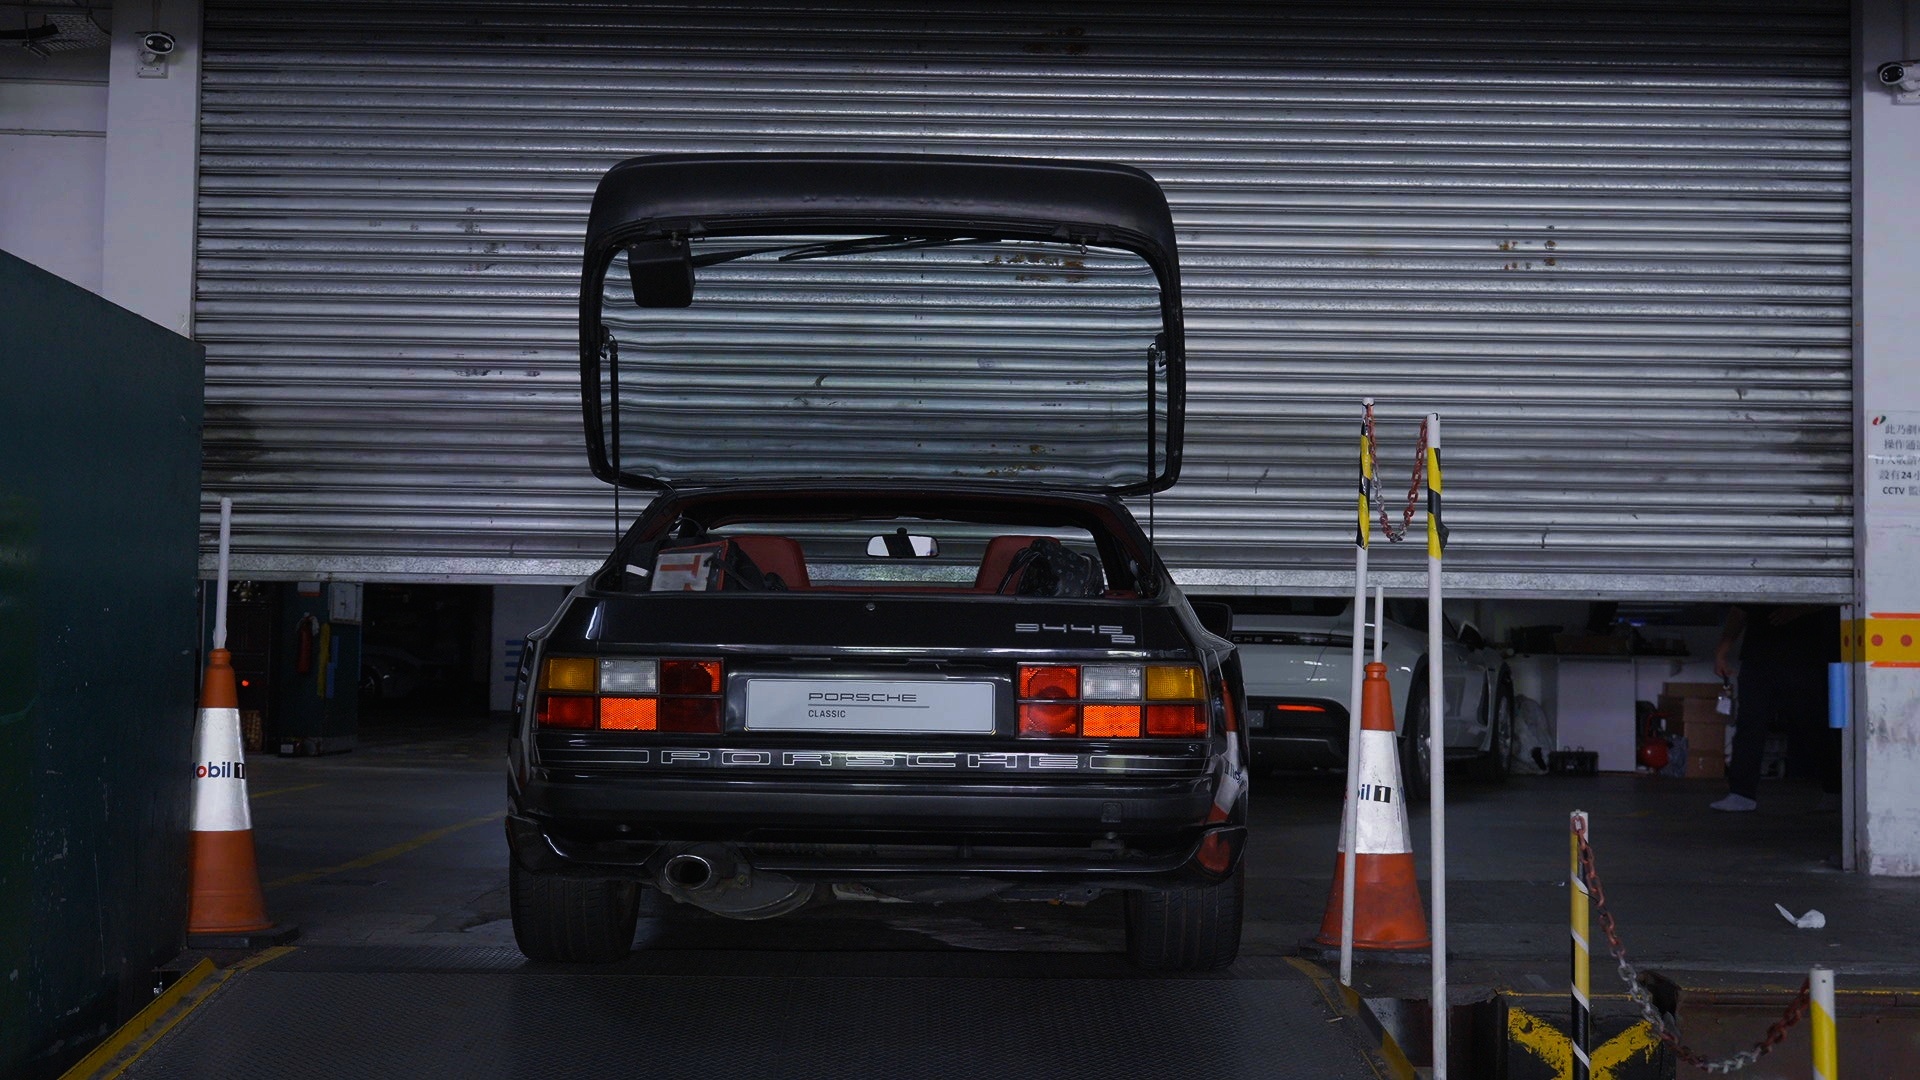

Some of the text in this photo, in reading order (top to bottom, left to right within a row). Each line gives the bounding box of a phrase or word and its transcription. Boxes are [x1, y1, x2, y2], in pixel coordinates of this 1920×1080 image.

[1882, 486, 1905, 495] CCTV
[809, 692, 917, 702] PORSCHE
[808, 709, 846, 718] CLASSIC
[661, 750, 1078, 769] PORSCHE
